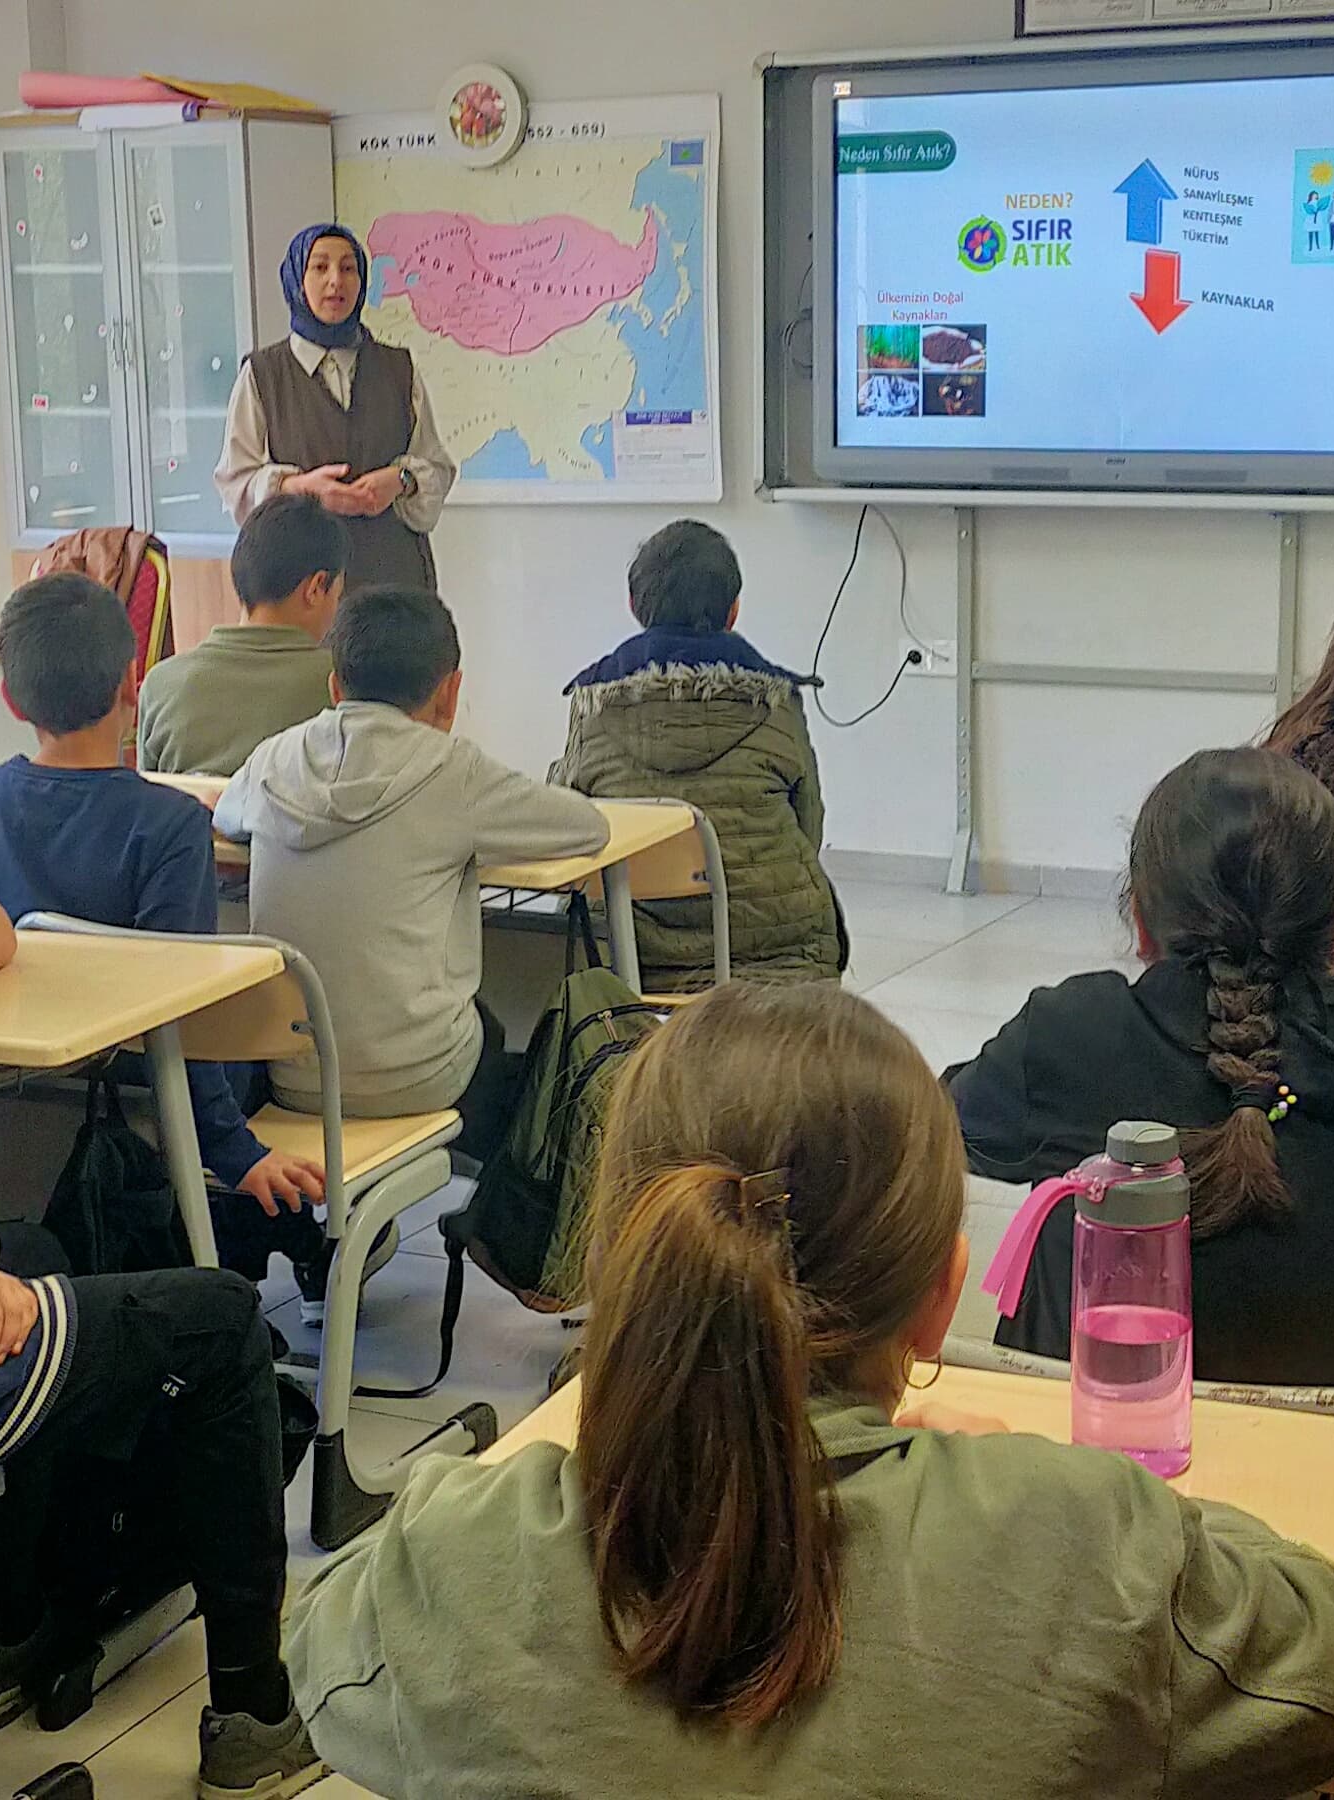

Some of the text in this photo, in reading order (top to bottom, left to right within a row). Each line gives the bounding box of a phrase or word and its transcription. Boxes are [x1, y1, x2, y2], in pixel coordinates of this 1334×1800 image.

[838, 145, 880, 163] Neden
[1184, 166, 1219, 181] NÜFUS
[1005, 192, 1073, 209] NEDEN?
[1183, 188, 1255, 207] SANAYİLEŞME
[1183, 209, 1243, 227] KENTLEŞME
[1012, 219, 1072, 241] SIFIR
[1182, 229, 1229, 245] TÜKETİM
[1012, 243, 1072, 266] ATIK
[877, 290, 964, 304] Ülkemizin Doğal
[1201, 290, 1274, 312] KAYNAKLAR
